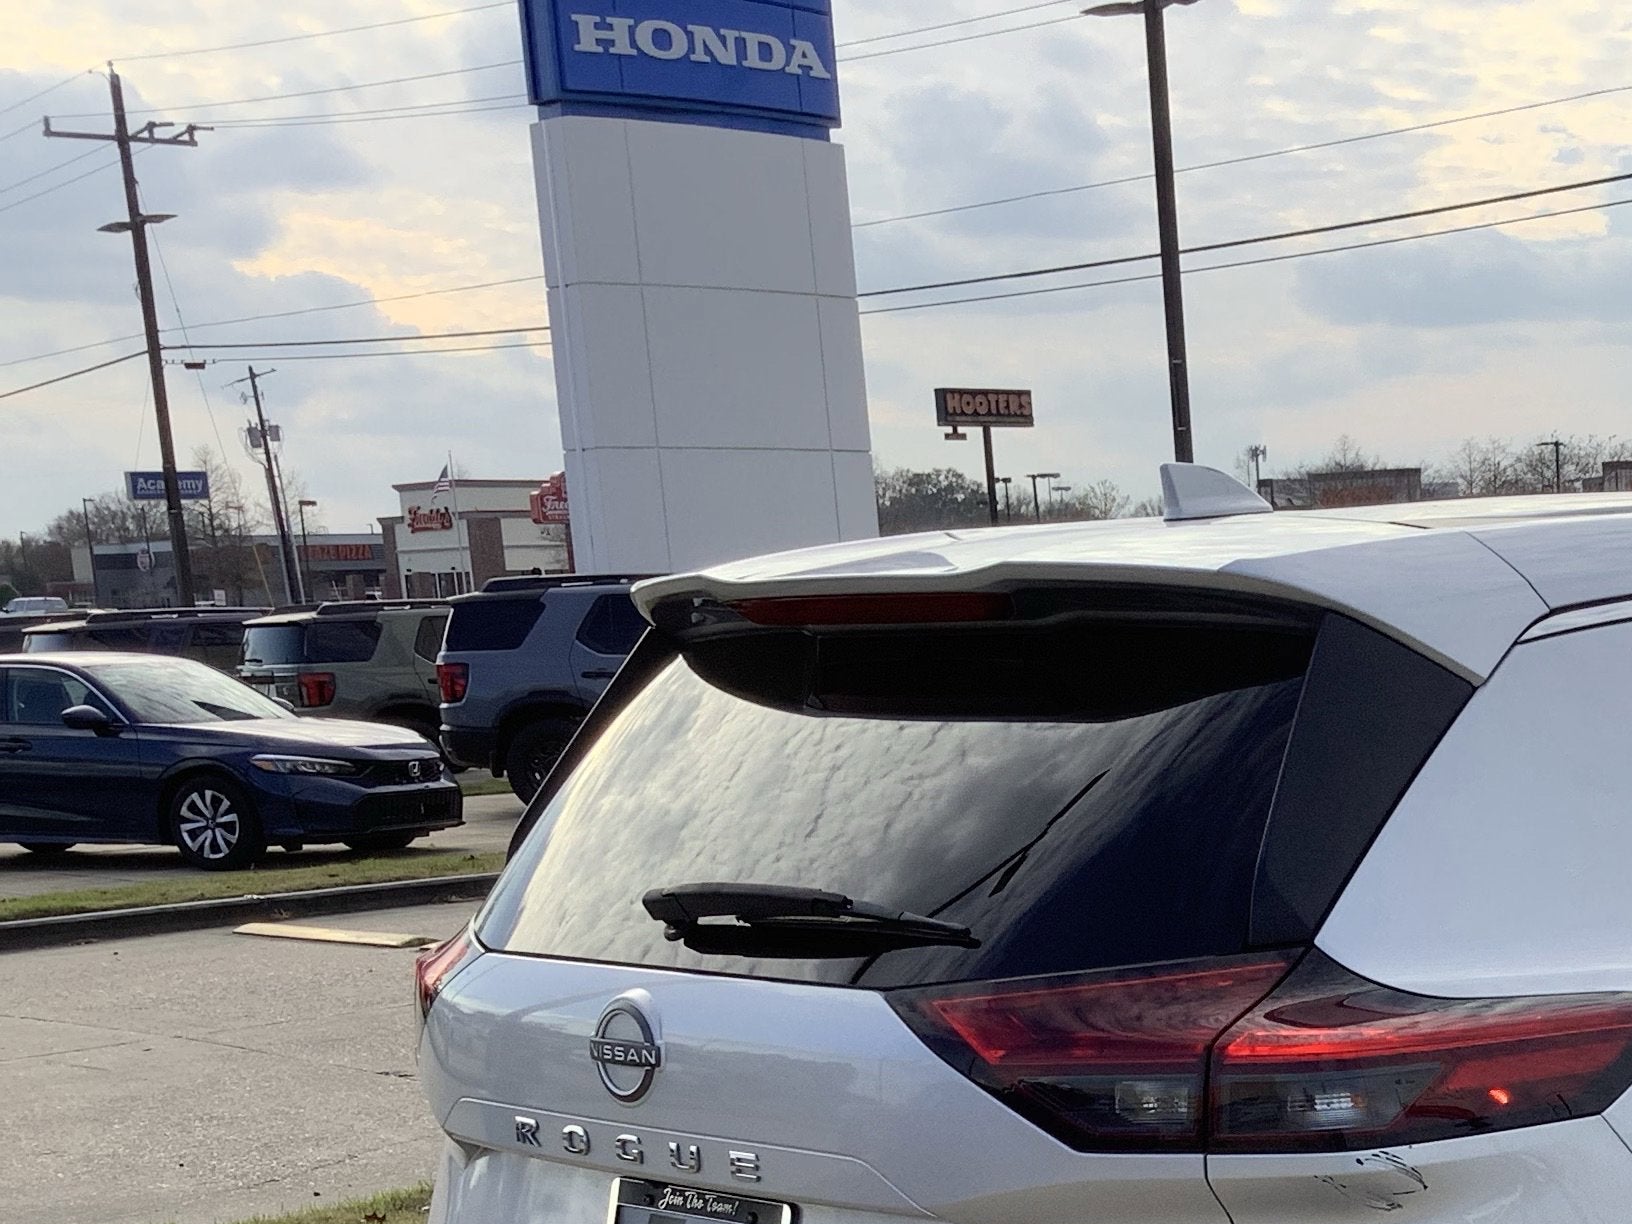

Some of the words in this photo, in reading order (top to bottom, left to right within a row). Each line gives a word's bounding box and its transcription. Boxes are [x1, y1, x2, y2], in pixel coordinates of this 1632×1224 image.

[570, 14, 831, 79] HONDA
[945, 391, 1032, 416] HOOTERS
[137, 477, 203, 493] Acaemy
[590, 1042, 656, 1065] NISSAN
[514, 1115, 762, 1183] ROGUE
[658, 1187, 684, 1210] Join
[685, 1191, 704, 1209] The
[705, 1195, 739, 1216] Team!
